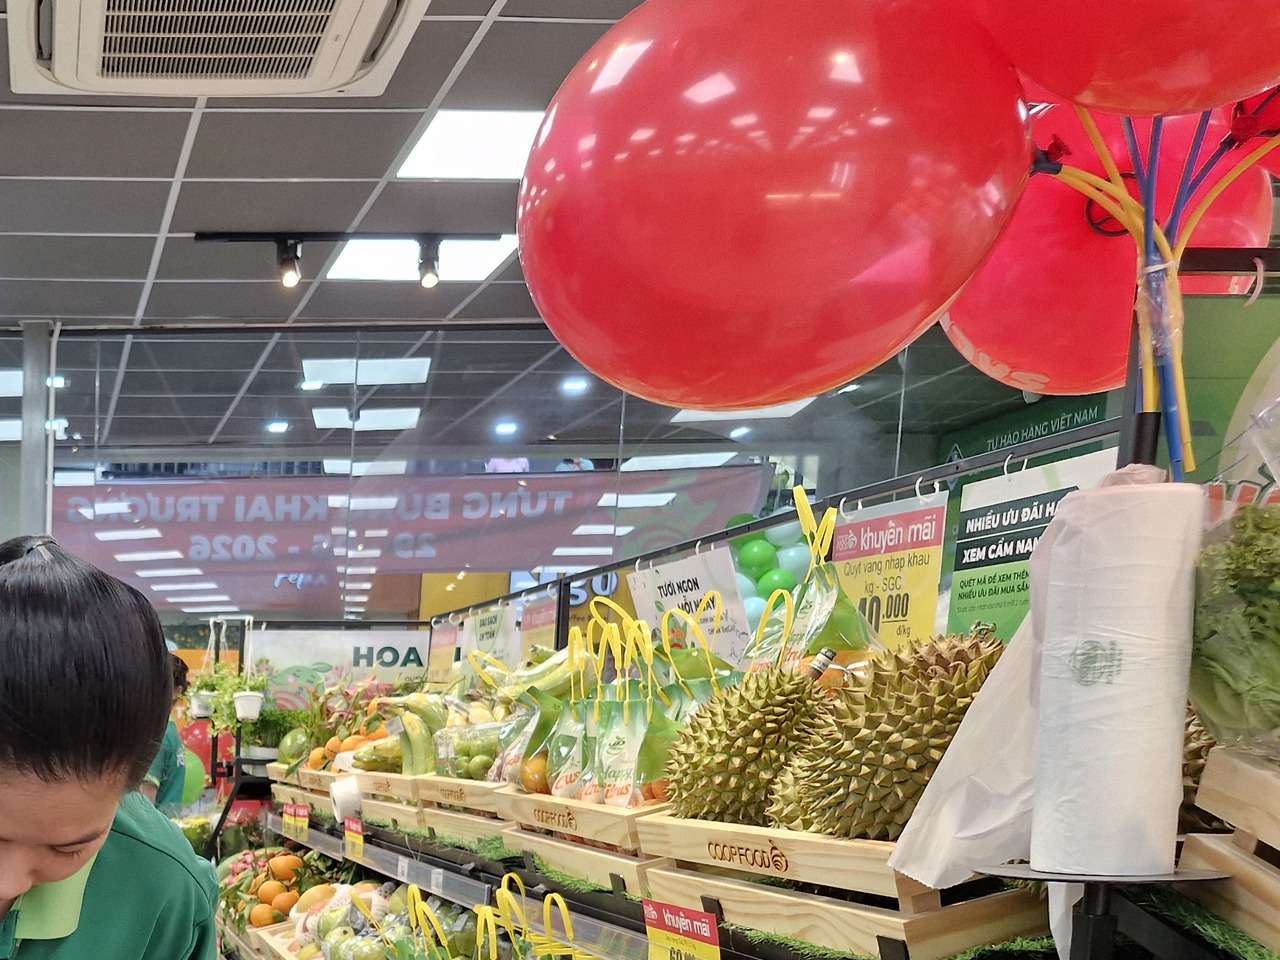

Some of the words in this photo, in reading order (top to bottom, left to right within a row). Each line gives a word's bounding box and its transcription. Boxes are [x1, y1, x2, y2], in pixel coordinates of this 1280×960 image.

[1021, 423, 1049, 440] HÀNG
[1073, 406, 1098, 425] NAM
[907, 514, 936, 543] mãi
[965, 510, 1000, 533] NHIỀU
[1002, 508, 1019, 526] ƯU
[1020, 501, 1044, 522] ĐÃI
[962, 546, 986, 564] XEM
[987, 537, 1013, 559] CẨM
[843, 562, 862, 578] Quyt
[863, 561, 882, 575] vang
[885, 556, 905, 572] nhap
[907, 552, 930, 567] khau
[657, 580, 677, 598] TƯƠI
[676, 577, 700, 595] NGON
[864, 581, 874, 595] kg
[882, 575, 902, 592] SGC
[957, 587, 976, 600] NHIỀU
[1000, 584, 1016, 594] MUA
[959, 575, 976, 590] QUÉT
[998, 572, 1012, 582] XEM
[353, 646, 424, 669] HOA
[693, 918, 711, 938] mãi
